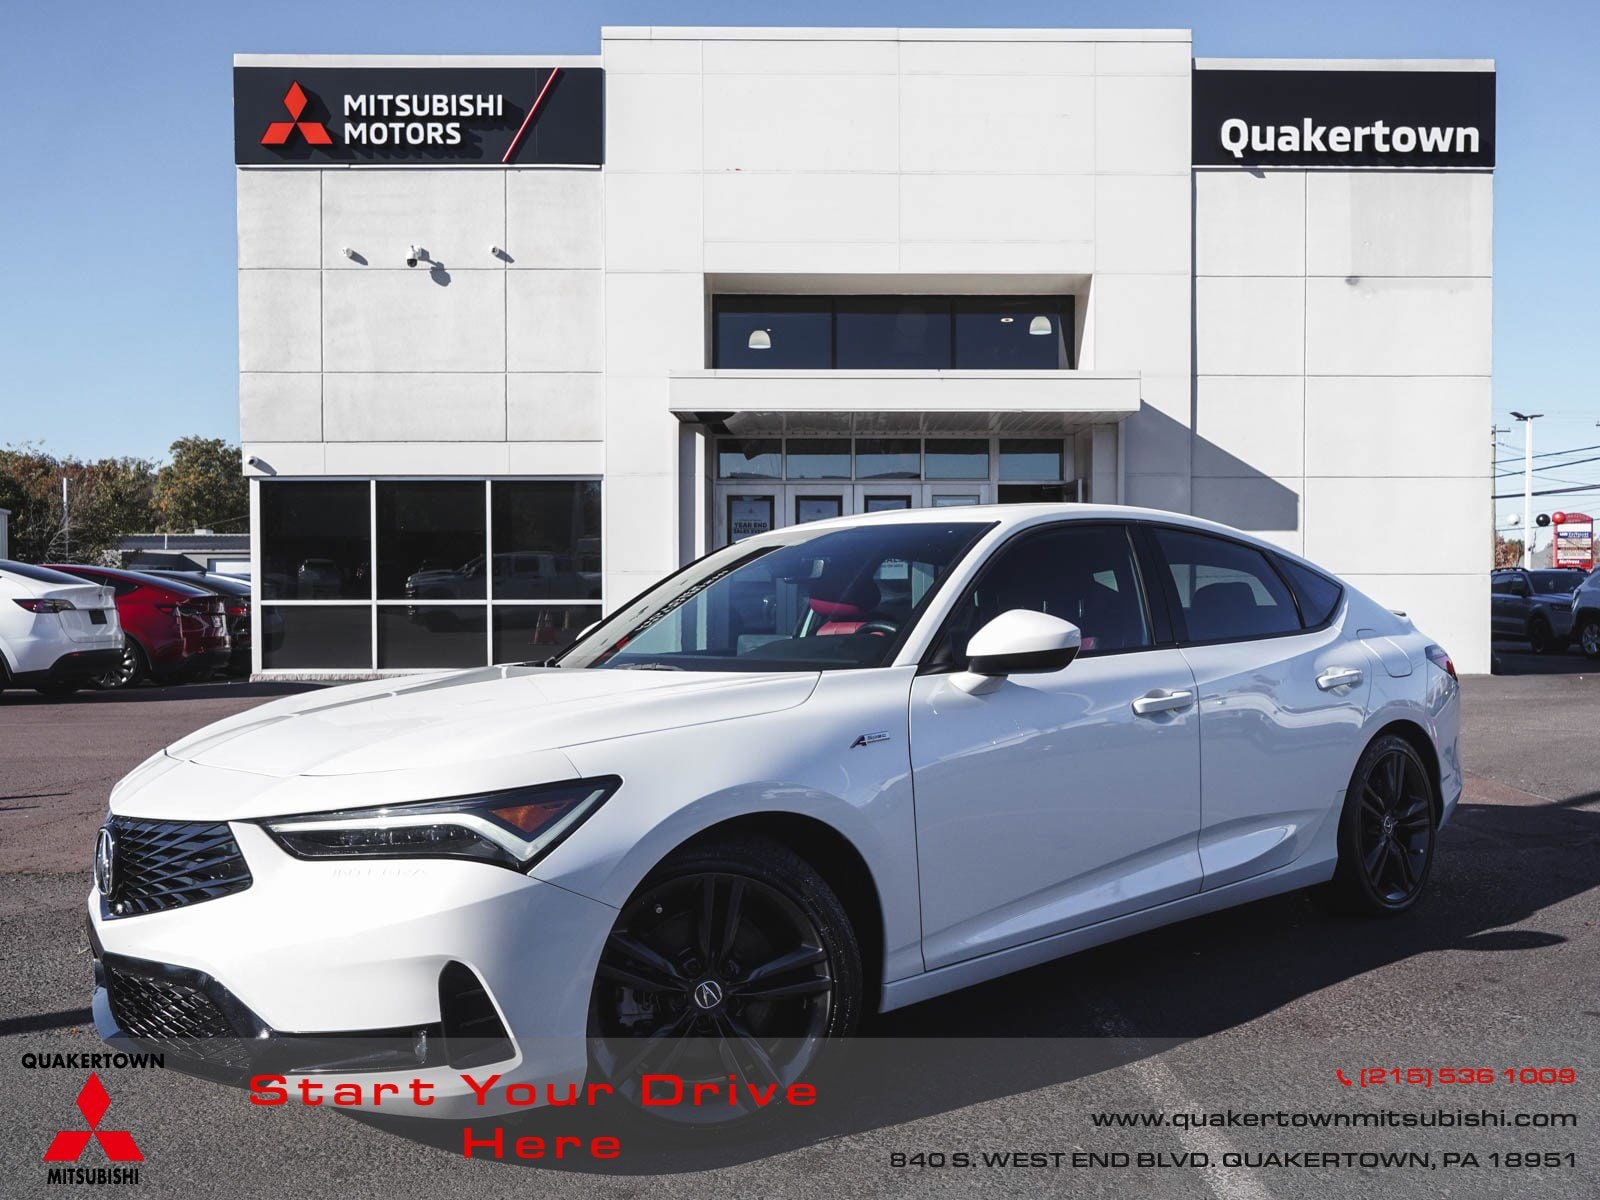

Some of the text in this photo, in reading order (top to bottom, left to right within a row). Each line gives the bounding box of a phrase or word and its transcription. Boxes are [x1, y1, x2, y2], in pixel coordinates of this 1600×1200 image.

[344, 94, 503, 117] MITSUBISHI
[344, 121, 461, 145] MOTORS
[1220, 117, 1480, 158] Quakertown
